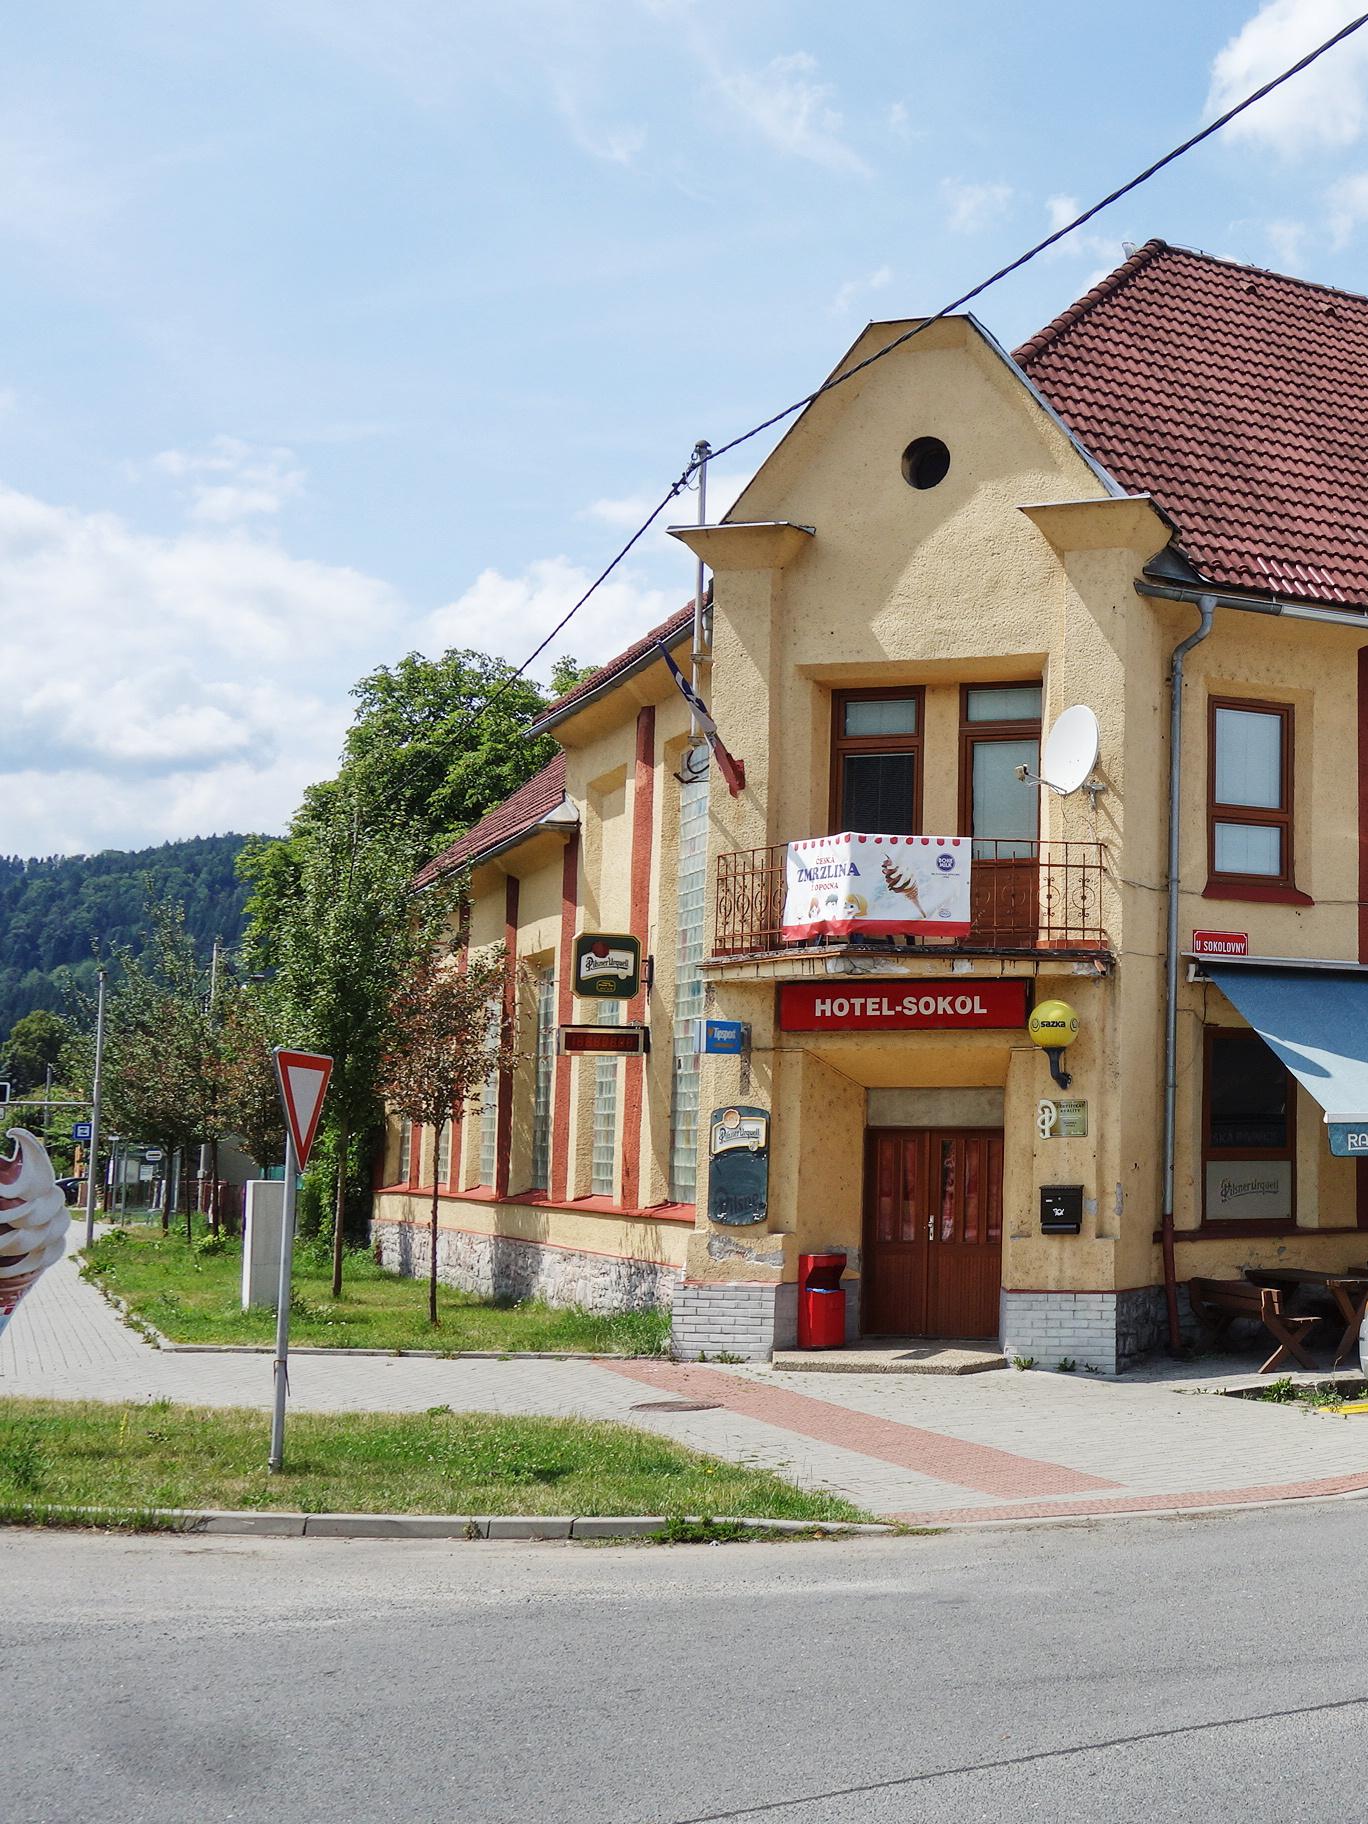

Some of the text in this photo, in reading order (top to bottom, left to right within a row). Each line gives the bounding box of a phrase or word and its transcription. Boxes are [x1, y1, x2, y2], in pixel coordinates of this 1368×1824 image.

[797, 862, 861, 883] ZMRZLINA
[1196, 940, 1246, 954] U SOKOLOVNY
[815, 995, 987, 1017] HOTEL-SOKOL
